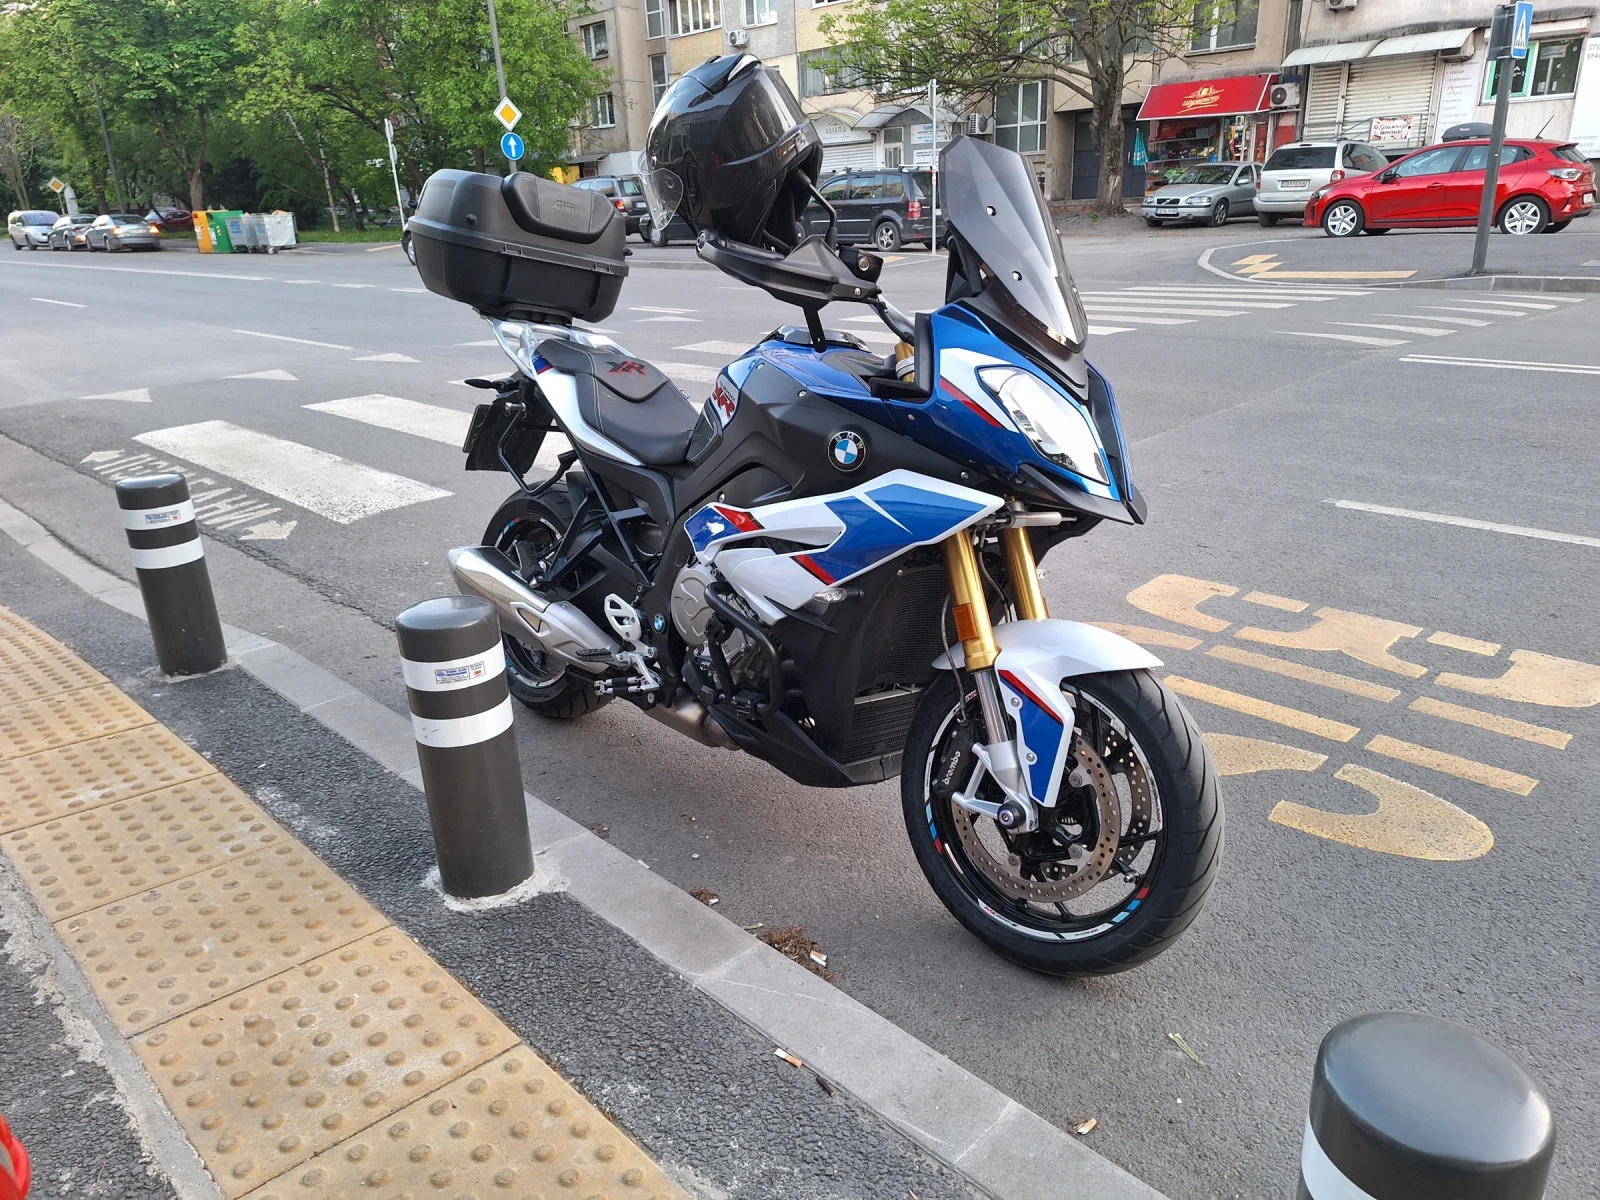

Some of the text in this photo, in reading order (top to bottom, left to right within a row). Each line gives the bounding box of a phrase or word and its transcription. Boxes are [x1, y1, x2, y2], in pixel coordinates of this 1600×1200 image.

[605, 360, 647, 377] XR
[712, 386, 736, 419] XR
[942, 751, 961, 785] brembo
